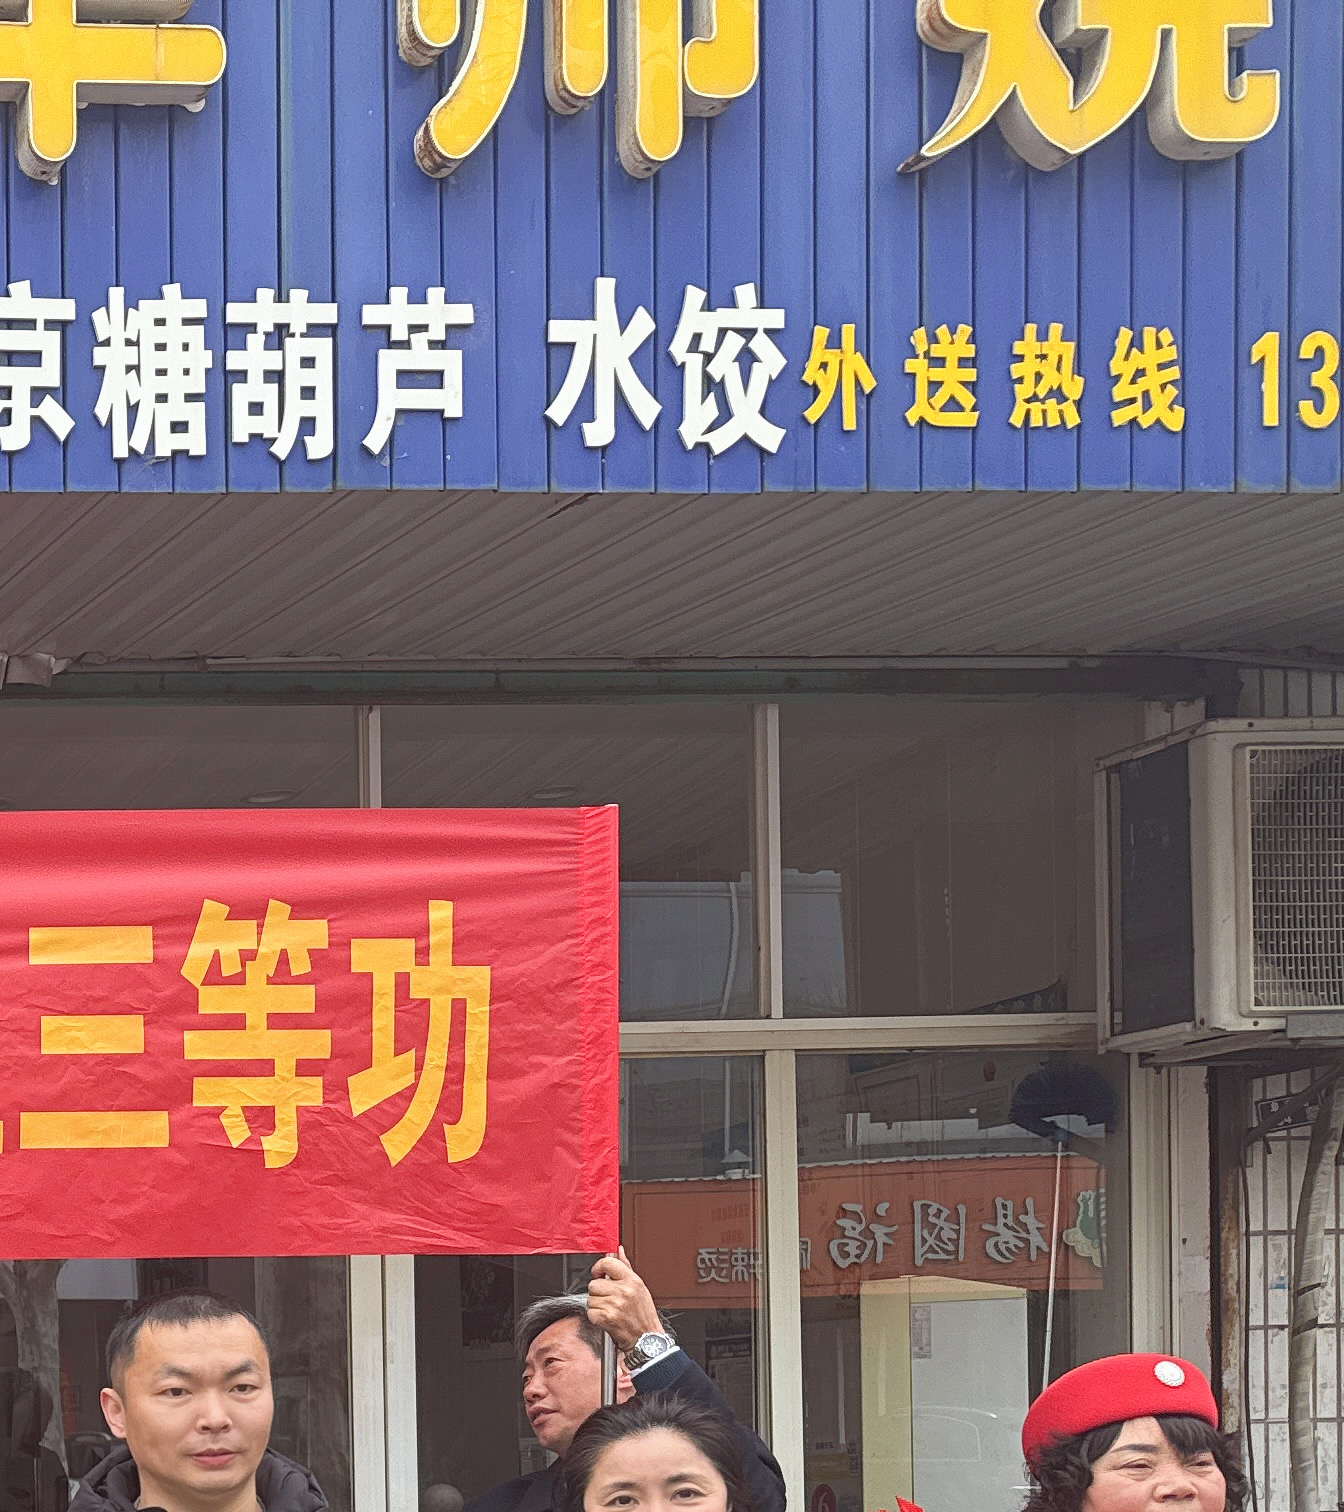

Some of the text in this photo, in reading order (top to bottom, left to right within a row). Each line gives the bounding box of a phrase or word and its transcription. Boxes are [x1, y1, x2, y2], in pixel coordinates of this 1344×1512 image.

[544, 276, 788, 455] 水饺
[800, 322, 1341, 433] 外送热线 13
